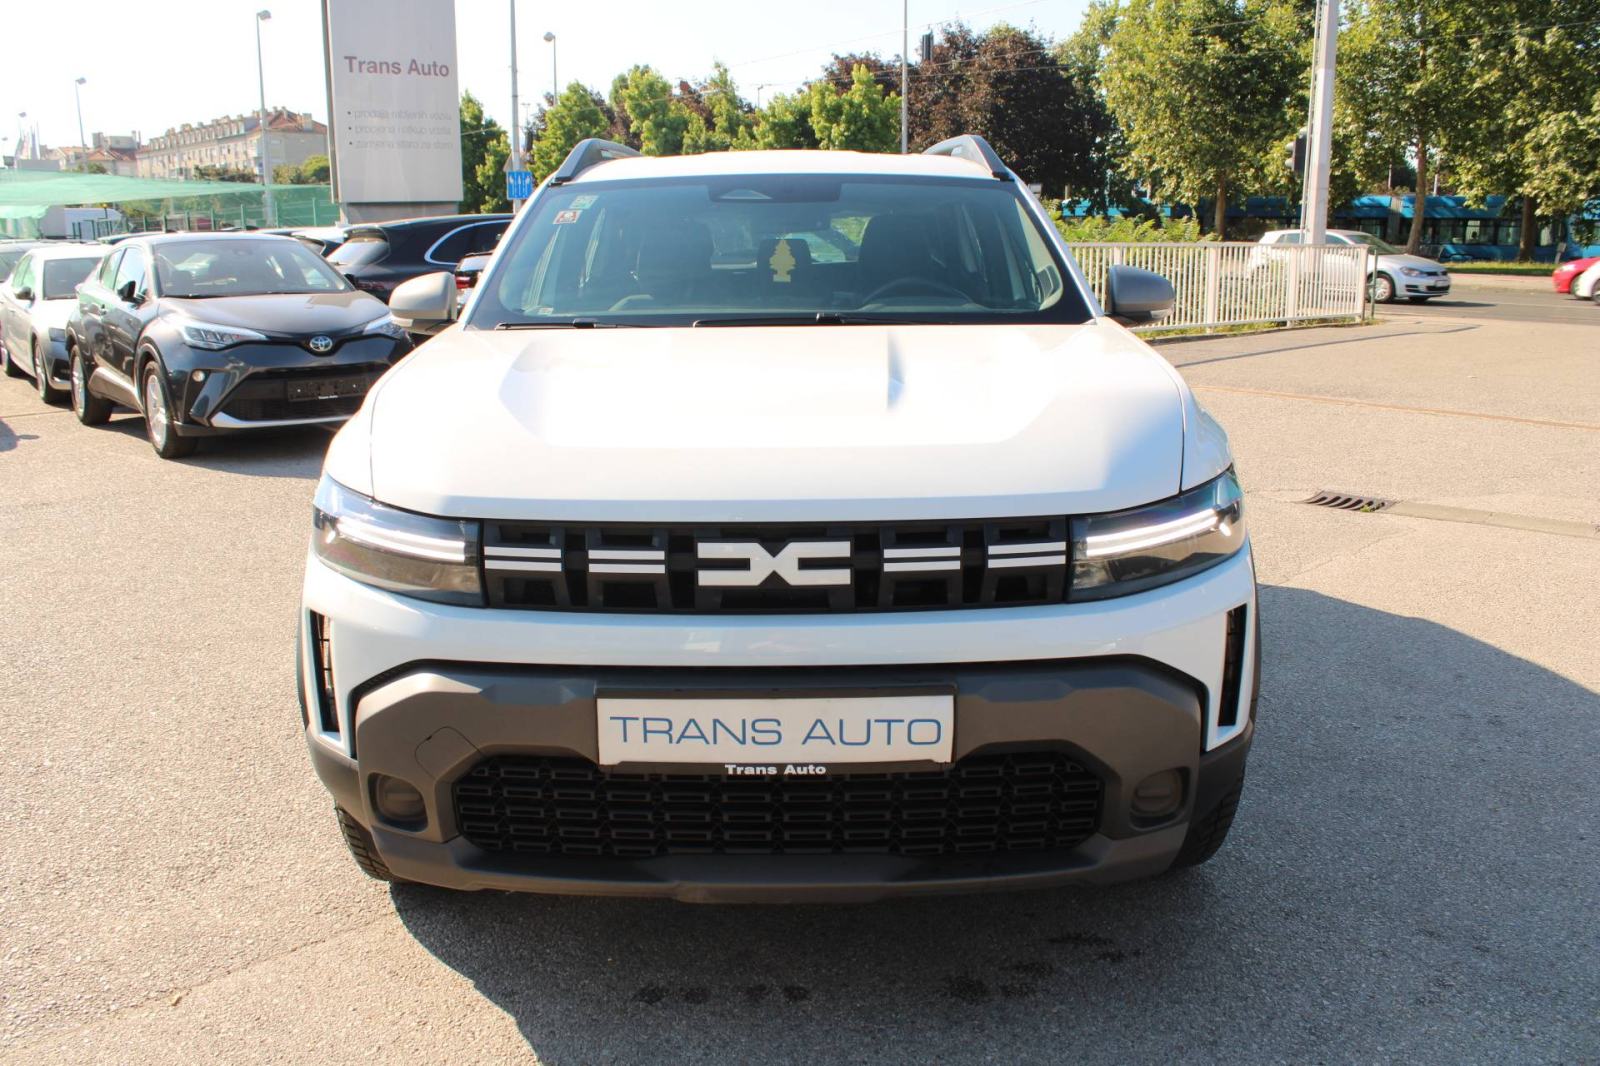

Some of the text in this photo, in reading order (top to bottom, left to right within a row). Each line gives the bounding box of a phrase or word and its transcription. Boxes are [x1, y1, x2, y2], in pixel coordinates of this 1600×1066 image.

[344, 56, 450, 77] Trans Auto
[609, 716, 942, 746] TRANS AUTO
[725, 764, 827, 775] Trans Auto
